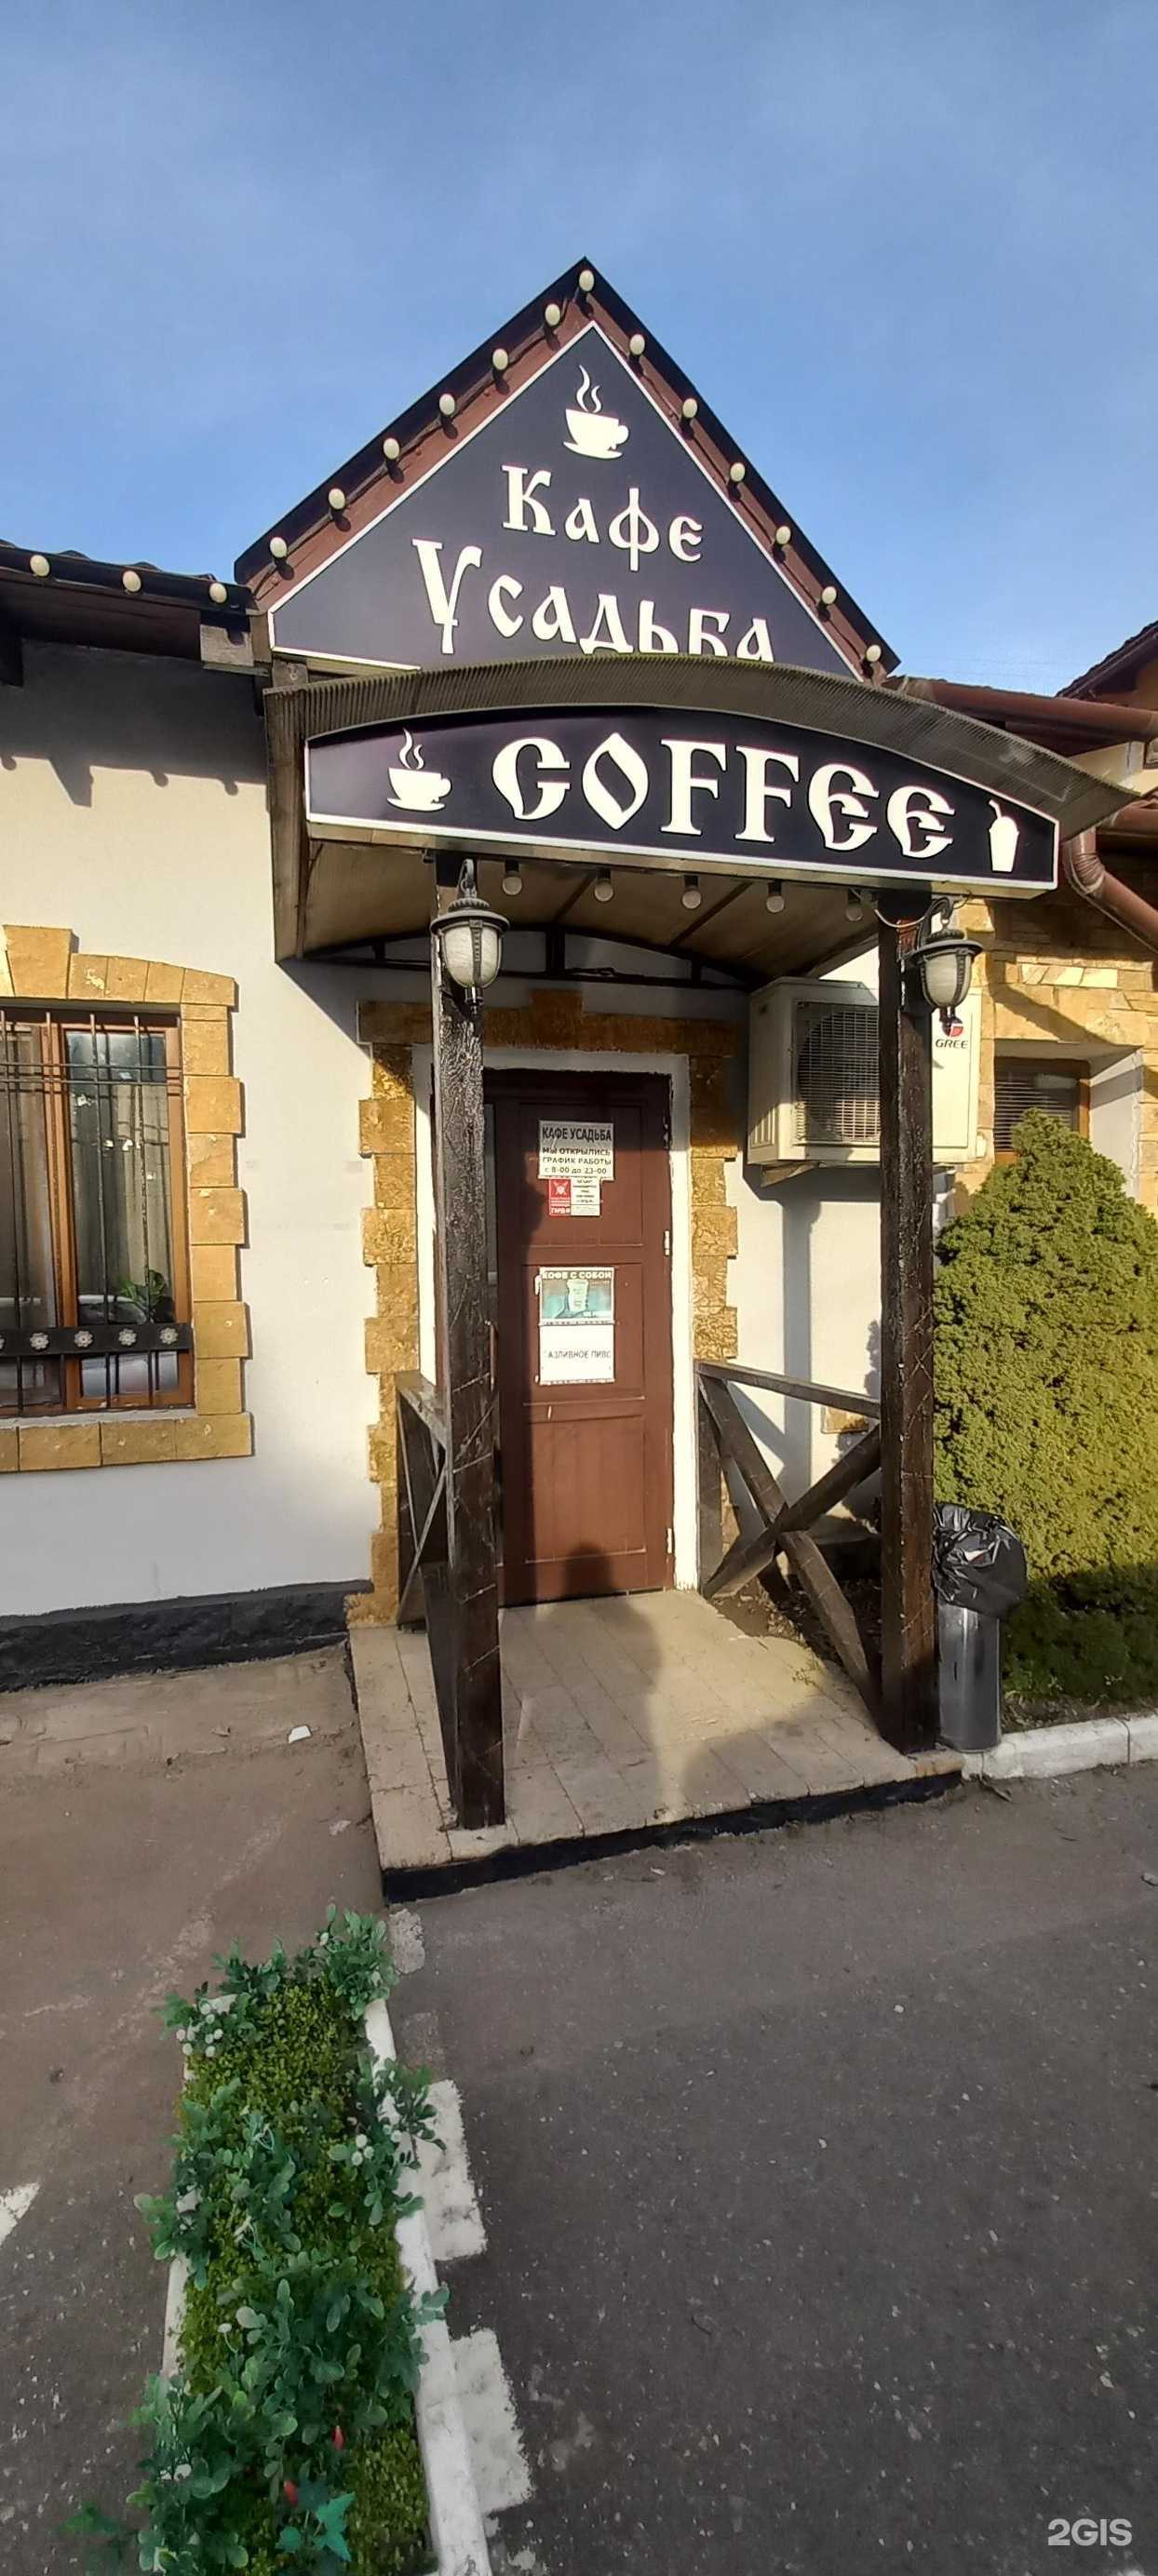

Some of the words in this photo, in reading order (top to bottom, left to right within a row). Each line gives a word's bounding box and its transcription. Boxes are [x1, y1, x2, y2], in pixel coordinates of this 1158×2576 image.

[502, 464, 704, 572] Кафе
[411, 537, 775, 664] Усадьба
[491, 731, 956, 860] COFFEE
[935, 1038, 969, 1050] GREE
[542, 1127, 568, 1140] КАФЕ
[570, 1128, 612, 1143] УСАДЬБА
[559, 1147, 611, 1156] ОТКРЫЛИСЬ
[543, 1156, 575, 1164] ГРАФИК
[545, 1349, 588, 1359] АЗЛИВНОЕ
